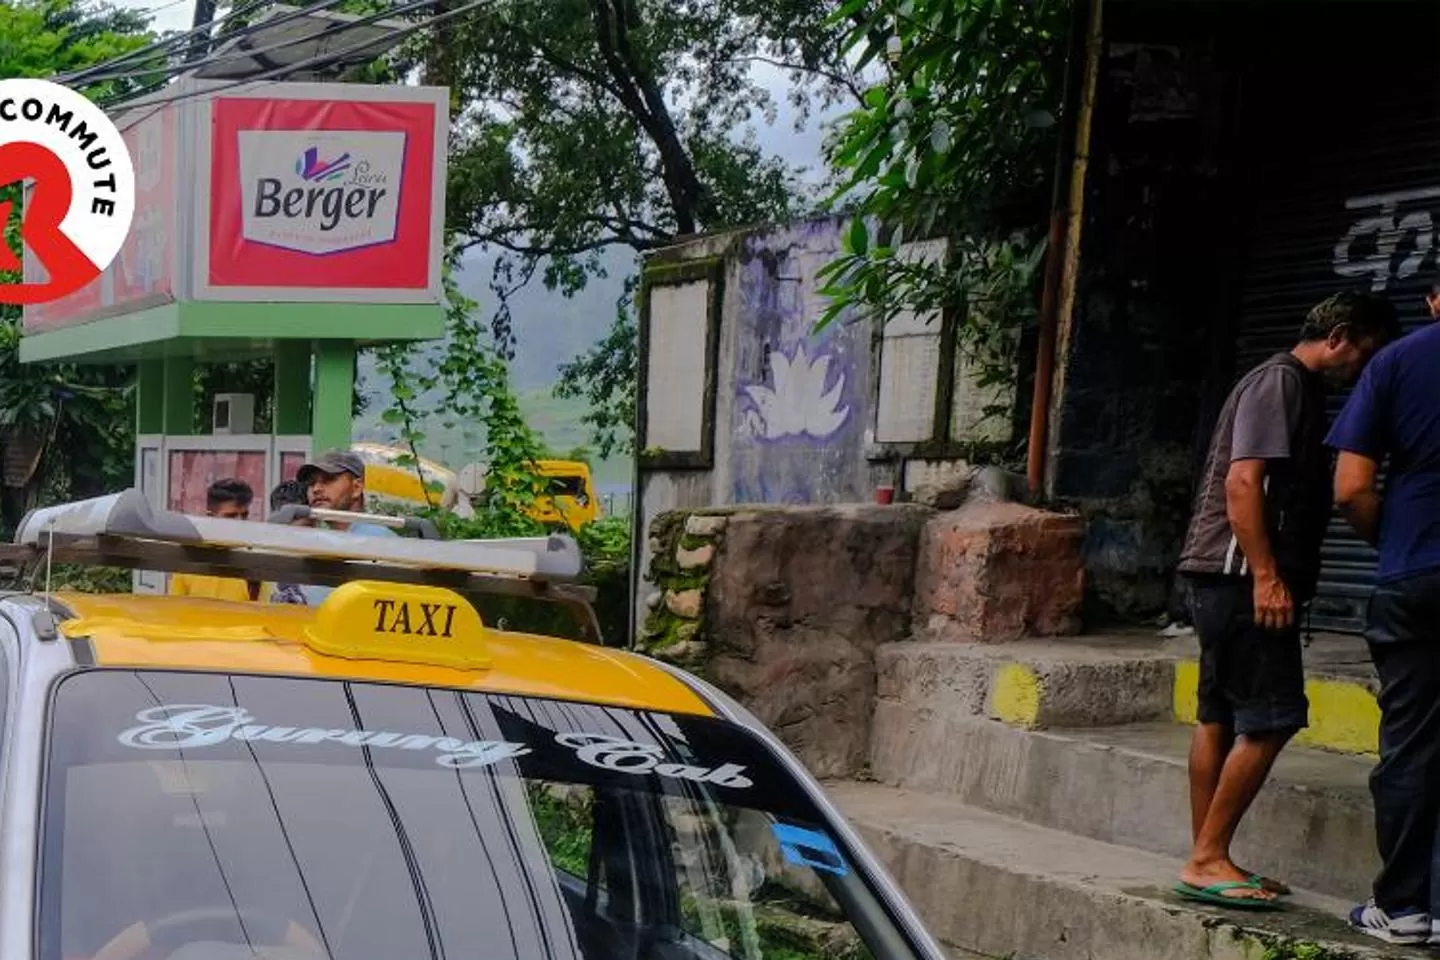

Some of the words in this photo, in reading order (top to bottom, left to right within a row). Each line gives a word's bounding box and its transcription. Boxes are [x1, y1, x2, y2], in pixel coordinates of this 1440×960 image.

[254, 178, 386, 231] Berger
[374, 599, 458, 638] TAXI
[117, 703, 532, 769] Gurung
[554, 732, 754, 788] Cab
